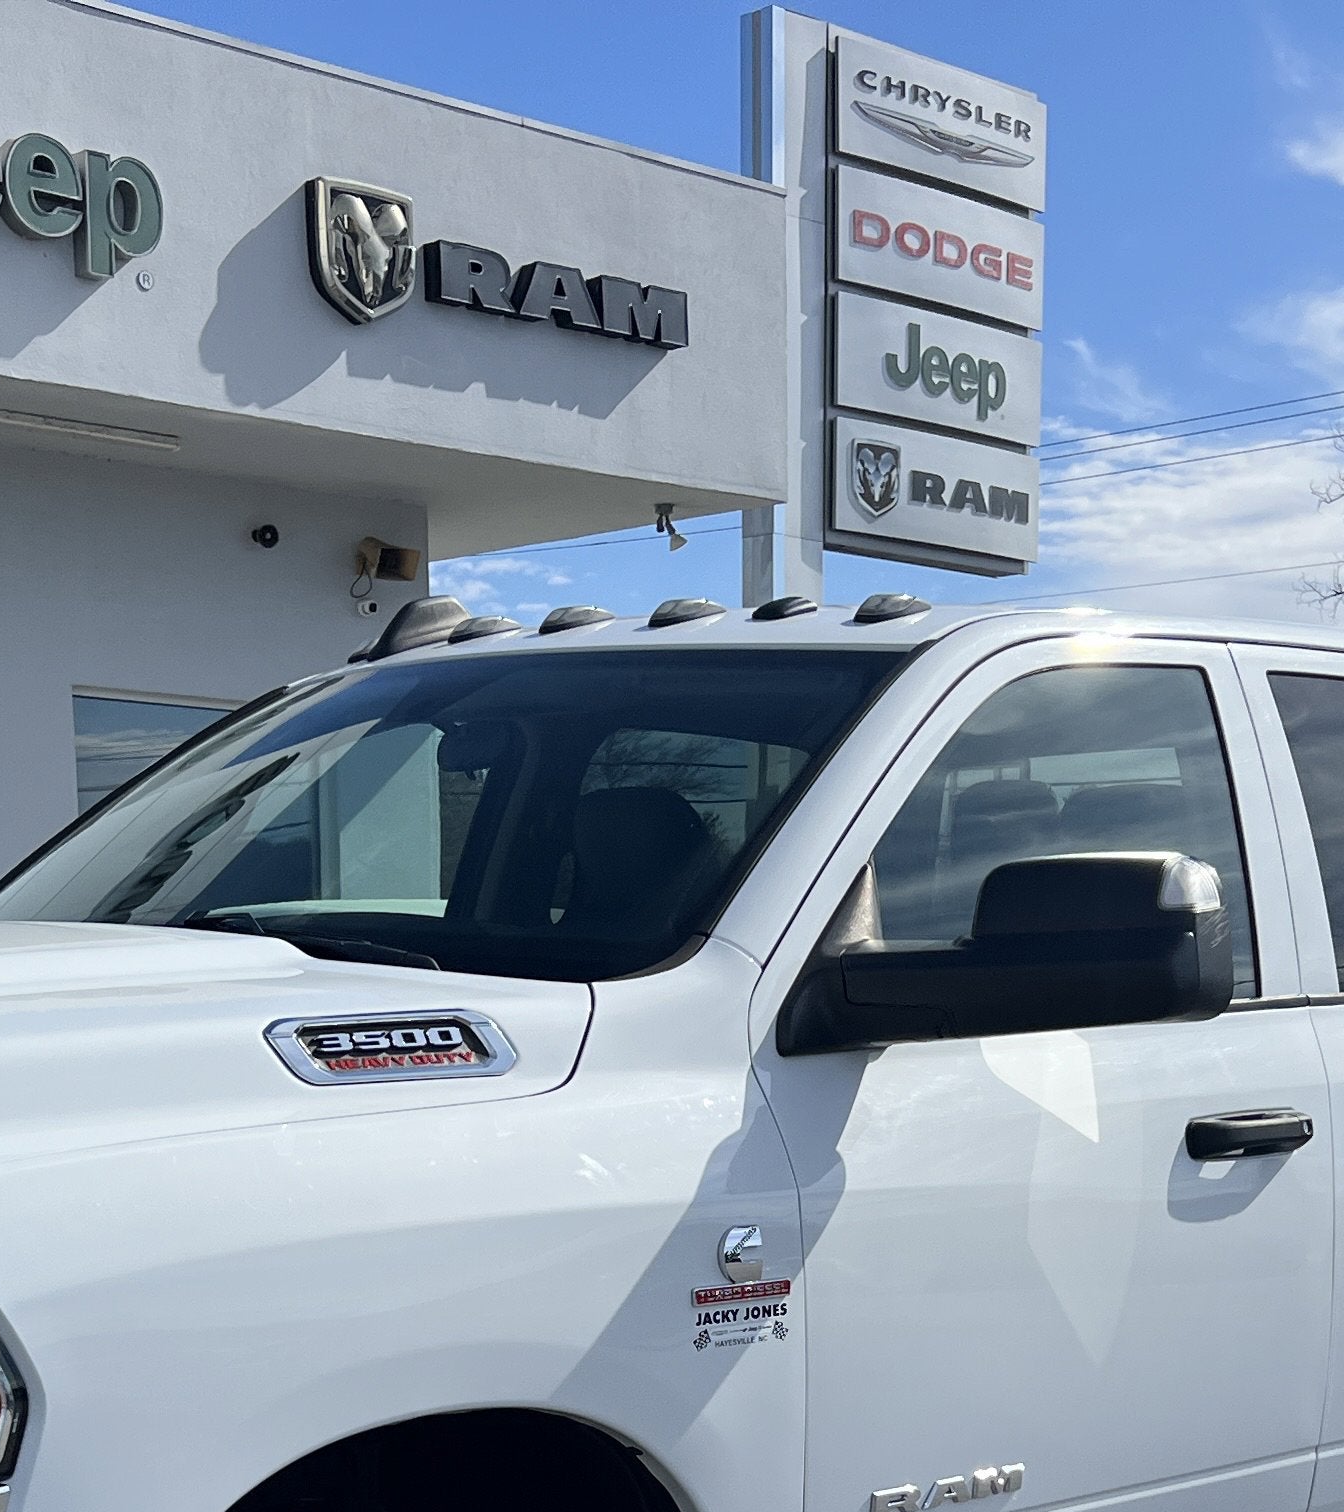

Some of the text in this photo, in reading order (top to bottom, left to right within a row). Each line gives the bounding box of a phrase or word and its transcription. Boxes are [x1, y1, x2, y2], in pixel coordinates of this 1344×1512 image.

[853, 69, 1033, 142] CHRYSLER
[851, 209, 1034, 291] DODGE
[425, 240, 689, 350] RAM
[885, 322, 1007, 422] Jeep
[910, 470, 1030, 525] RAM
[315, 1026, 464, 1052] 3500
[326, 1051, 474, 1071] HEAVY DUTY
[696, 1303, 788, 1326] JACKY JONES
